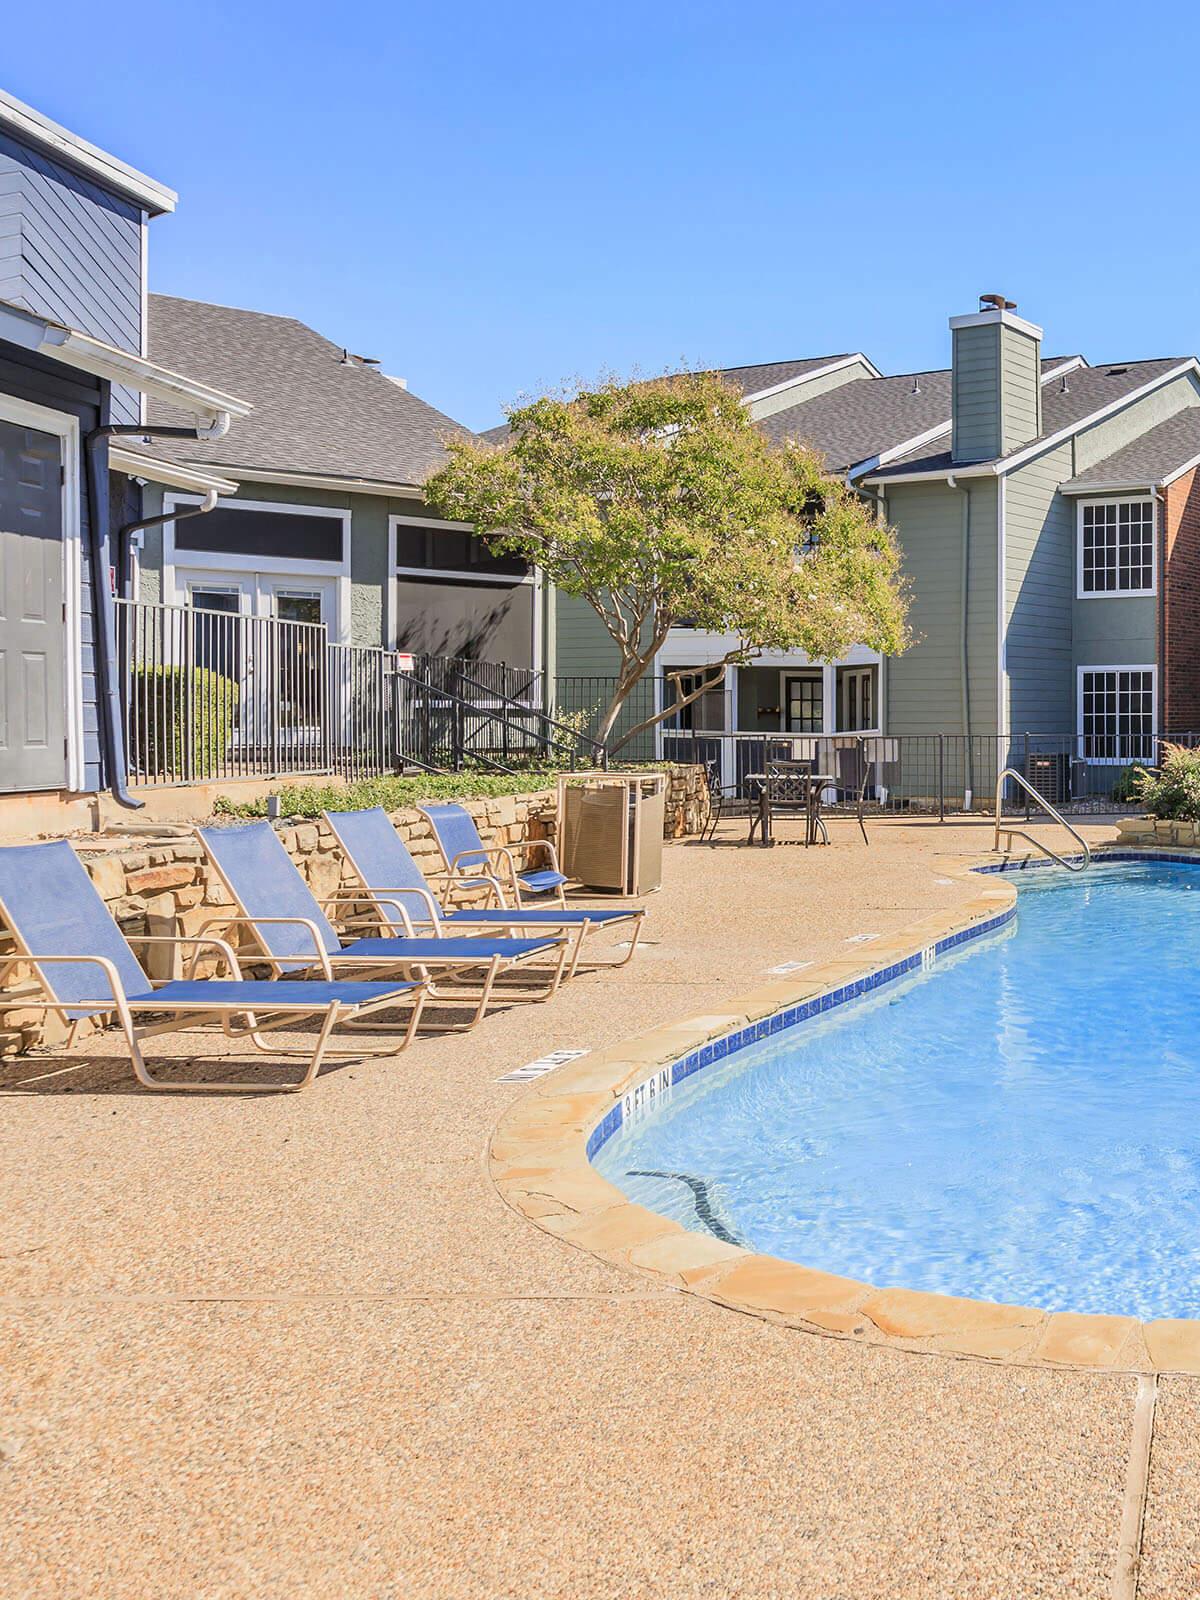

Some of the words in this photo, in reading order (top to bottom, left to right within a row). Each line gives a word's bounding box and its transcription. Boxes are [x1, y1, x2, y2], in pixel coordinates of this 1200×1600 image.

[625, 1096, 631, 1117] 3
[634, 1084, 645, 1110] FT
[650, 1078, 655, 1099] 6
[659, 1068, 670, 1092] IN
